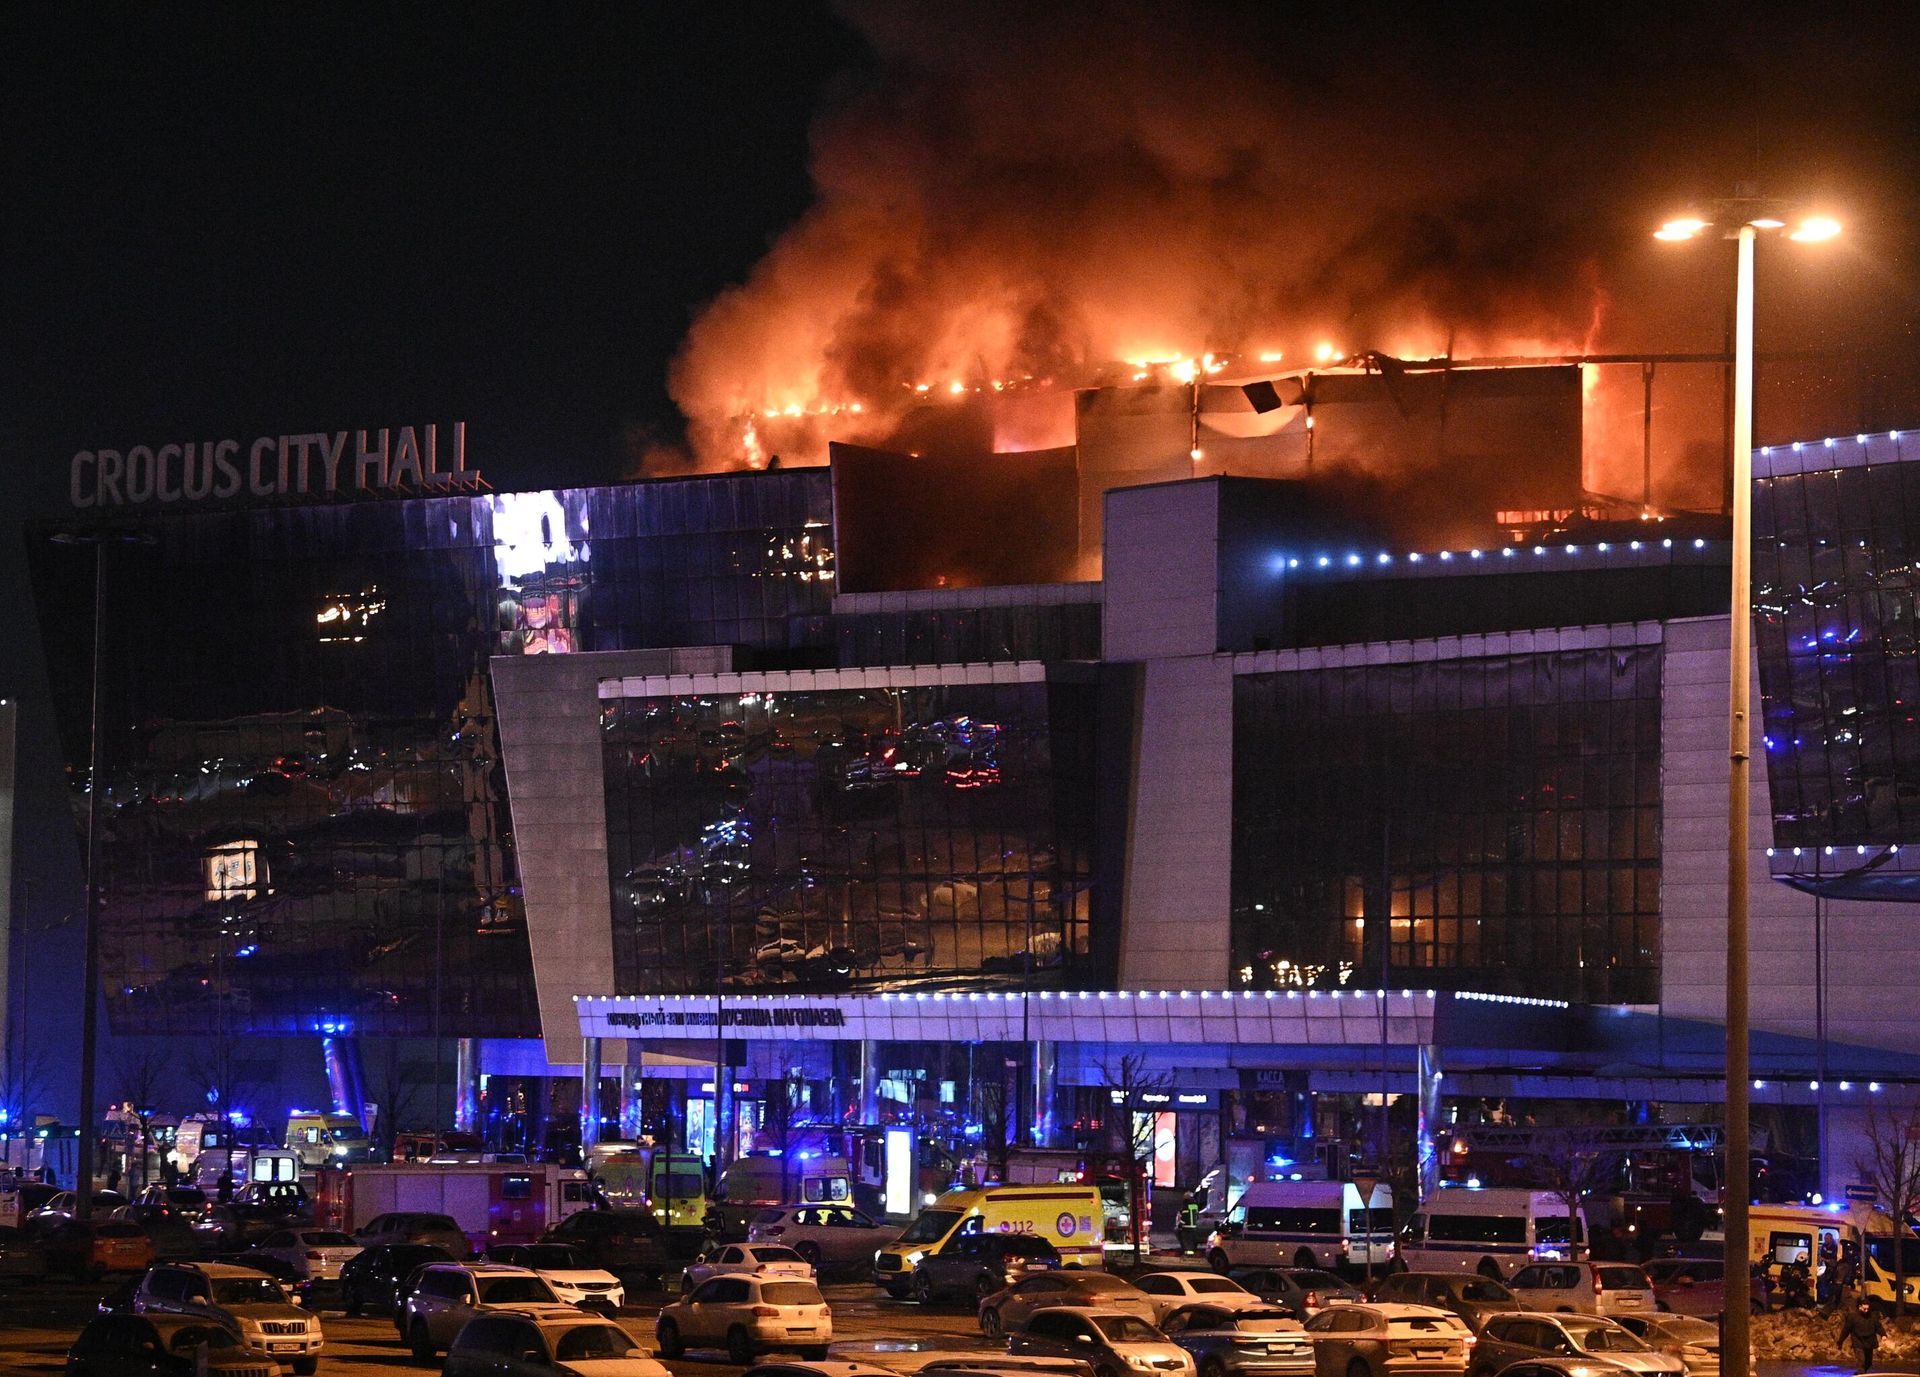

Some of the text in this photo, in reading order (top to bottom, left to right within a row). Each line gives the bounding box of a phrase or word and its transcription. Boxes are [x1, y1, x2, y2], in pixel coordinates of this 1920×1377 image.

[71, 421, 481, 508] CROCUS CITY HALL
[1013, 1220, 1034, 1232] 112
